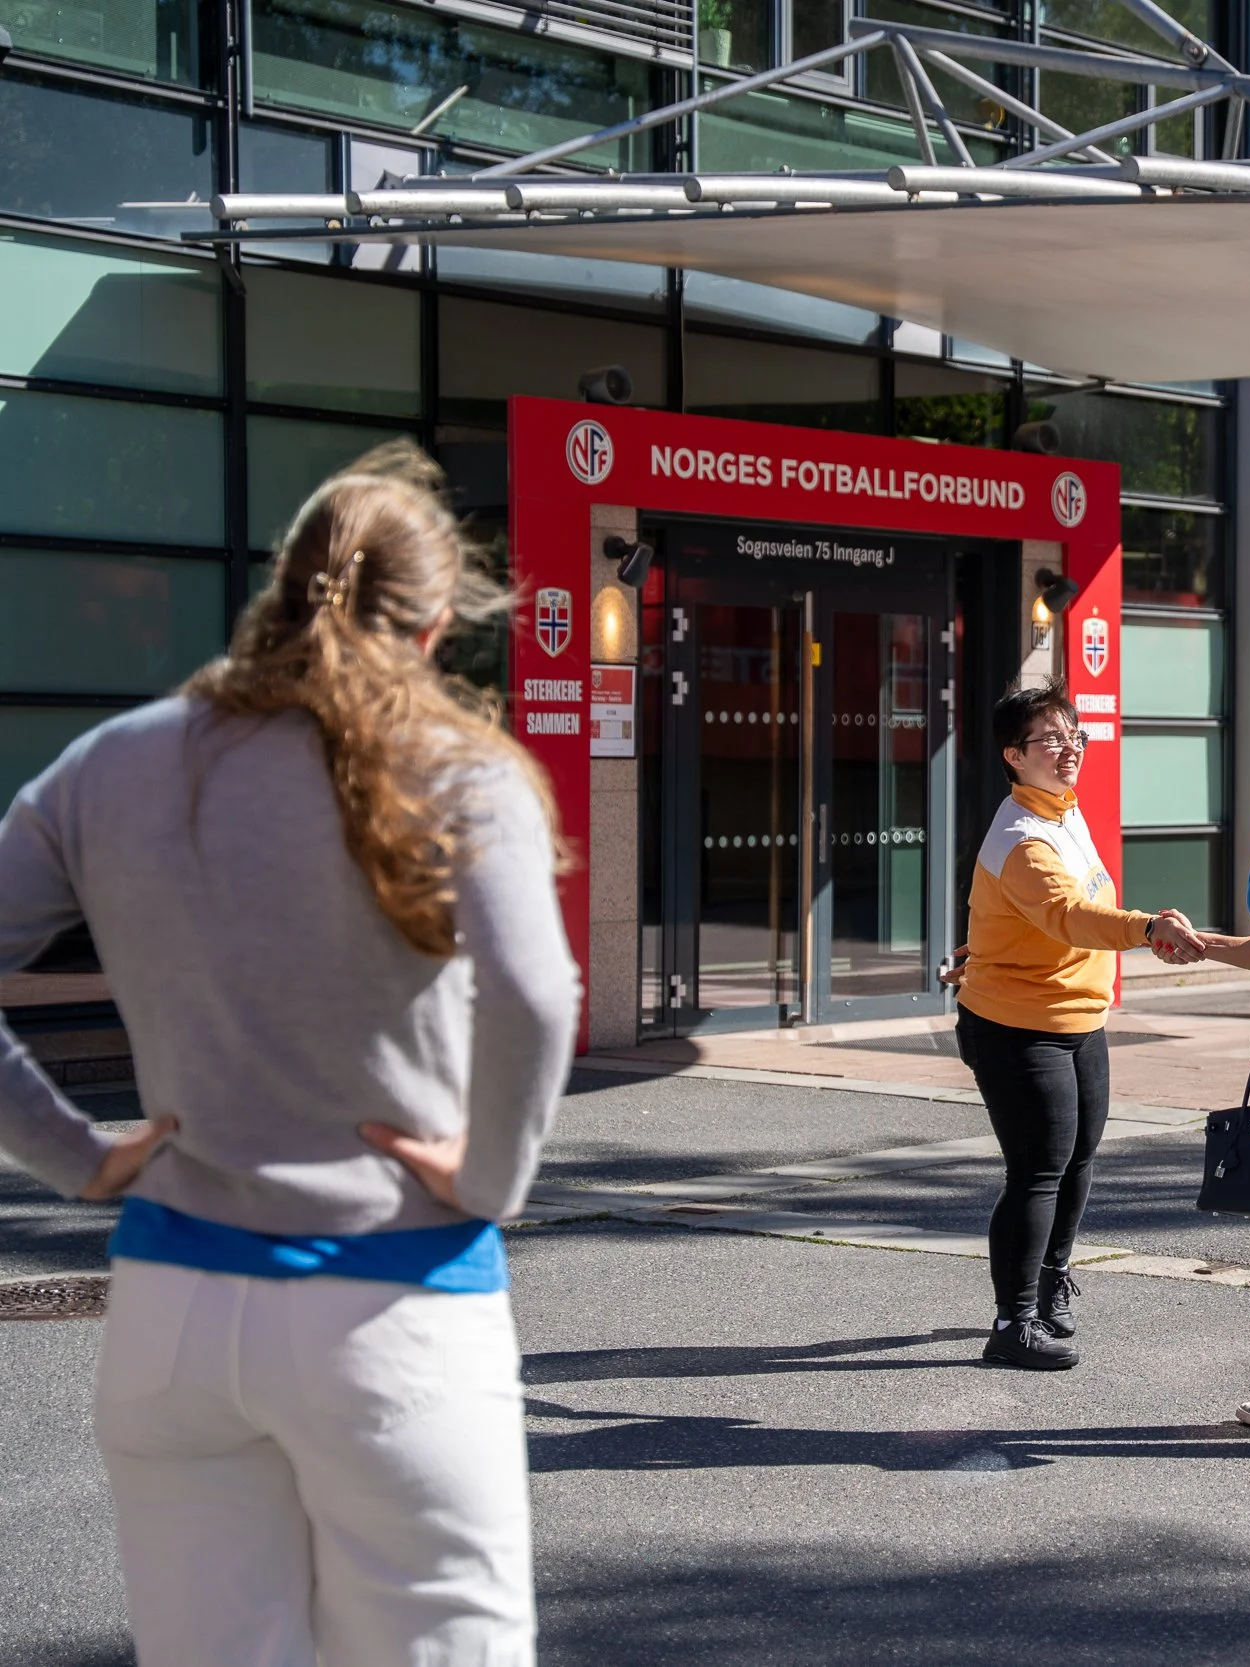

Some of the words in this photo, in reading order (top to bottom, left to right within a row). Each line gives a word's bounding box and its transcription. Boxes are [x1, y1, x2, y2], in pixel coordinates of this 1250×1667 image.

[651, 444, 773, 487] NORGES
[781, 458, 1026, 510] FOTBALLFORBUND
[737, 535, 812, 560] Sognsveien
[815, 541, 831, 560] 75
[833, 542, 884, 568] Inngang
[885, 546, 896, 564] J
[524, 678, 583, 702] STERKERE
[526, 712, 580, 735] SAMMEN
